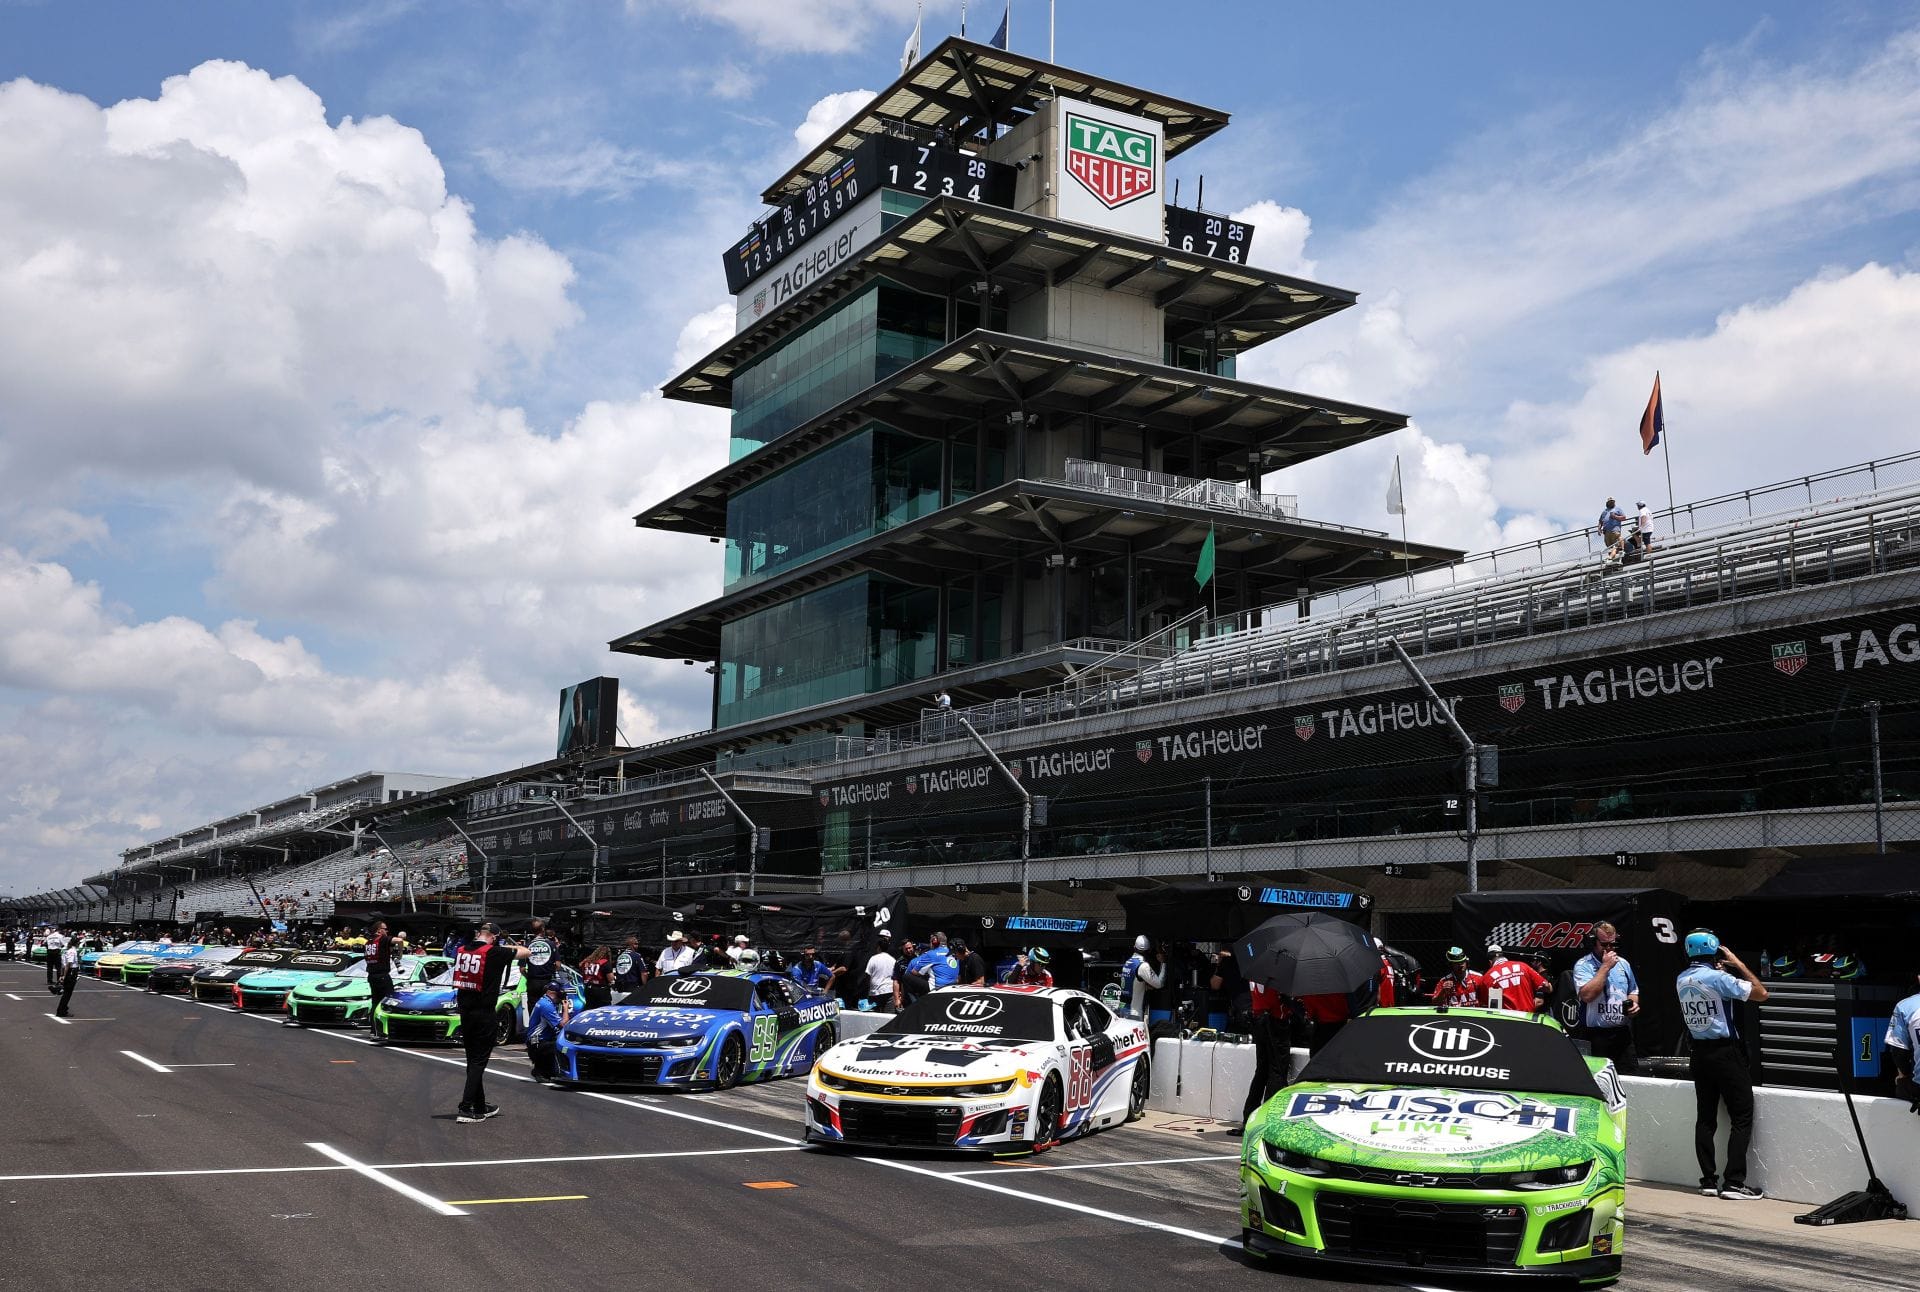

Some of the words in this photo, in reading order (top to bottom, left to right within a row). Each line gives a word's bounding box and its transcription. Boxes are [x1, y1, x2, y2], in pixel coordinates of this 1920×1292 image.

[1075, 122, 1146, 163] TAG
[918, 146, 930, 165] 7
[967, 160, 986, 179] 26
[889, 165, 898, 184] 1
[913, 170, 928, 191] 2
[941, 177, 954, 196] 3
[967, 184, 981, 202] 4
[1072, 154, 1149, 201] HEUER
[762, 224, 769, 240] 7
[783, 205, 793, 224] 26
[806, 189, 816, 206] 20
[818, 176, 828, 197] 25
[744, 260, 750, 277] 1
[754, 253, 761, 272] 2
[764, 245, 772, 262] 3
[776, 235, 783, 253] 4
[787, 227, 794, 245] 5
[799, 218, 806, 237] 6
[810, 208, 817, 228] 7
[823, 200, 830, 219] 8
[835, 190, 843, 209] 9
[846, 178, 858, 200] 10
[1205, 218, 1222, 236] 20
[1228, 223, 1244, 242] 25
[1182, 235, 1194, 252] 6
[1206, 240, 1217, 257] 7
[1228, 246, 1240, 264] 8
[688, 803, 702, 820] CUP
[702, 799, 726, 819] SERIES
[1446, 800, 1458, 809] 12
[1616, 855, 1626, 866] 31
[1274, 890, 1341, 907] TRACKHOUSE
[873, 907, 891, 928] 20
[1017, 918, 1078, 931] TRACKHOUSE
[1520, 921, 1594, 949] RCR
[1651, 917, 1678, 944] 3
[650, 997, 708, 1006] TRACKHOUSE
[1597, 1002, 1624, 1014] BUSC
[1681, 1000, 1718, 1016] USCH
[923, 1023, 1003, 1035] TRACKHOUSE
[1686, 1017, 1708, 1025] LIGHT
[585, 1028, 658, 1038] Freeway.com
[750, 1015, 778, 1063] 99
[1860, 1034, 1871, 1061] 1
[842, 1065, 968, 1079] WeatherTech.com
[1066, 1045, 1094, 1112] 88
[1384, 1062, 1511, 1080] TRACKHOUSE
[1283, 1092, 1579, 1137] BUSCH
[1381, 1113, 1466, 1124] LIGHT
[1369, 1121, 1473, 1137] LIME
[1277, 1180, 1288, 1195] 1
[1546, 1200, 1584, 1212] TRACKHOUSE
